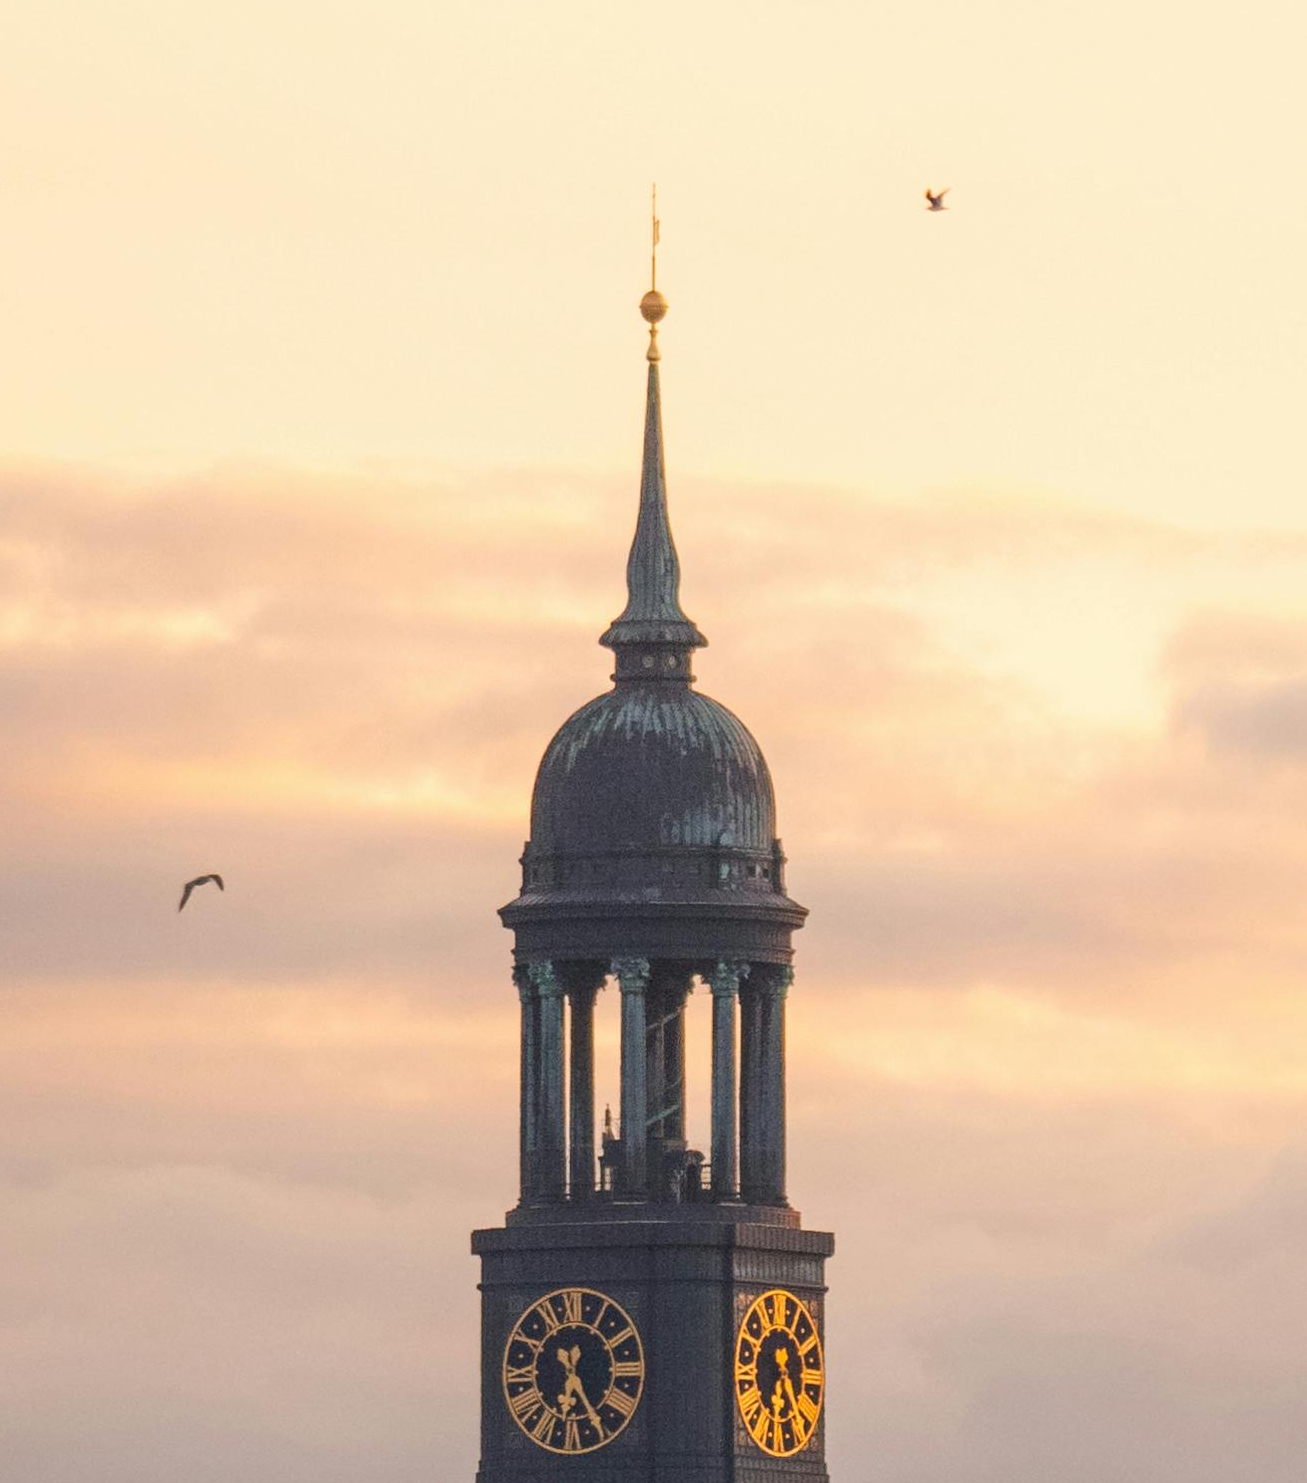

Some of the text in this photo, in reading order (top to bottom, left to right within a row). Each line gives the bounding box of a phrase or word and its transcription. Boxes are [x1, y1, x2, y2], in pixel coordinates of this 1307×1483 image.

[536, 1300, 560, 1333] XI
[562, 1293, 582, 1323] XII
[594, 1302, 609, 1328] I
[790, 1305, 802, 1332] I
[514, 1328, 544, 1352] X
[607, 1326, 633, 1349] II
[507, 1364, 534, 1382] IX
[615, 1362, 641, 1377] III
[738, 1363, 755, 1380] IX
[803, 1368, 822, 1385] III
[511, 1389, 542, 1423] VIII
[606, 1387, 635, 1416] IIII
[533, 1410, 556, 1444] VII
[563, 1420, 582, 1449] VI
